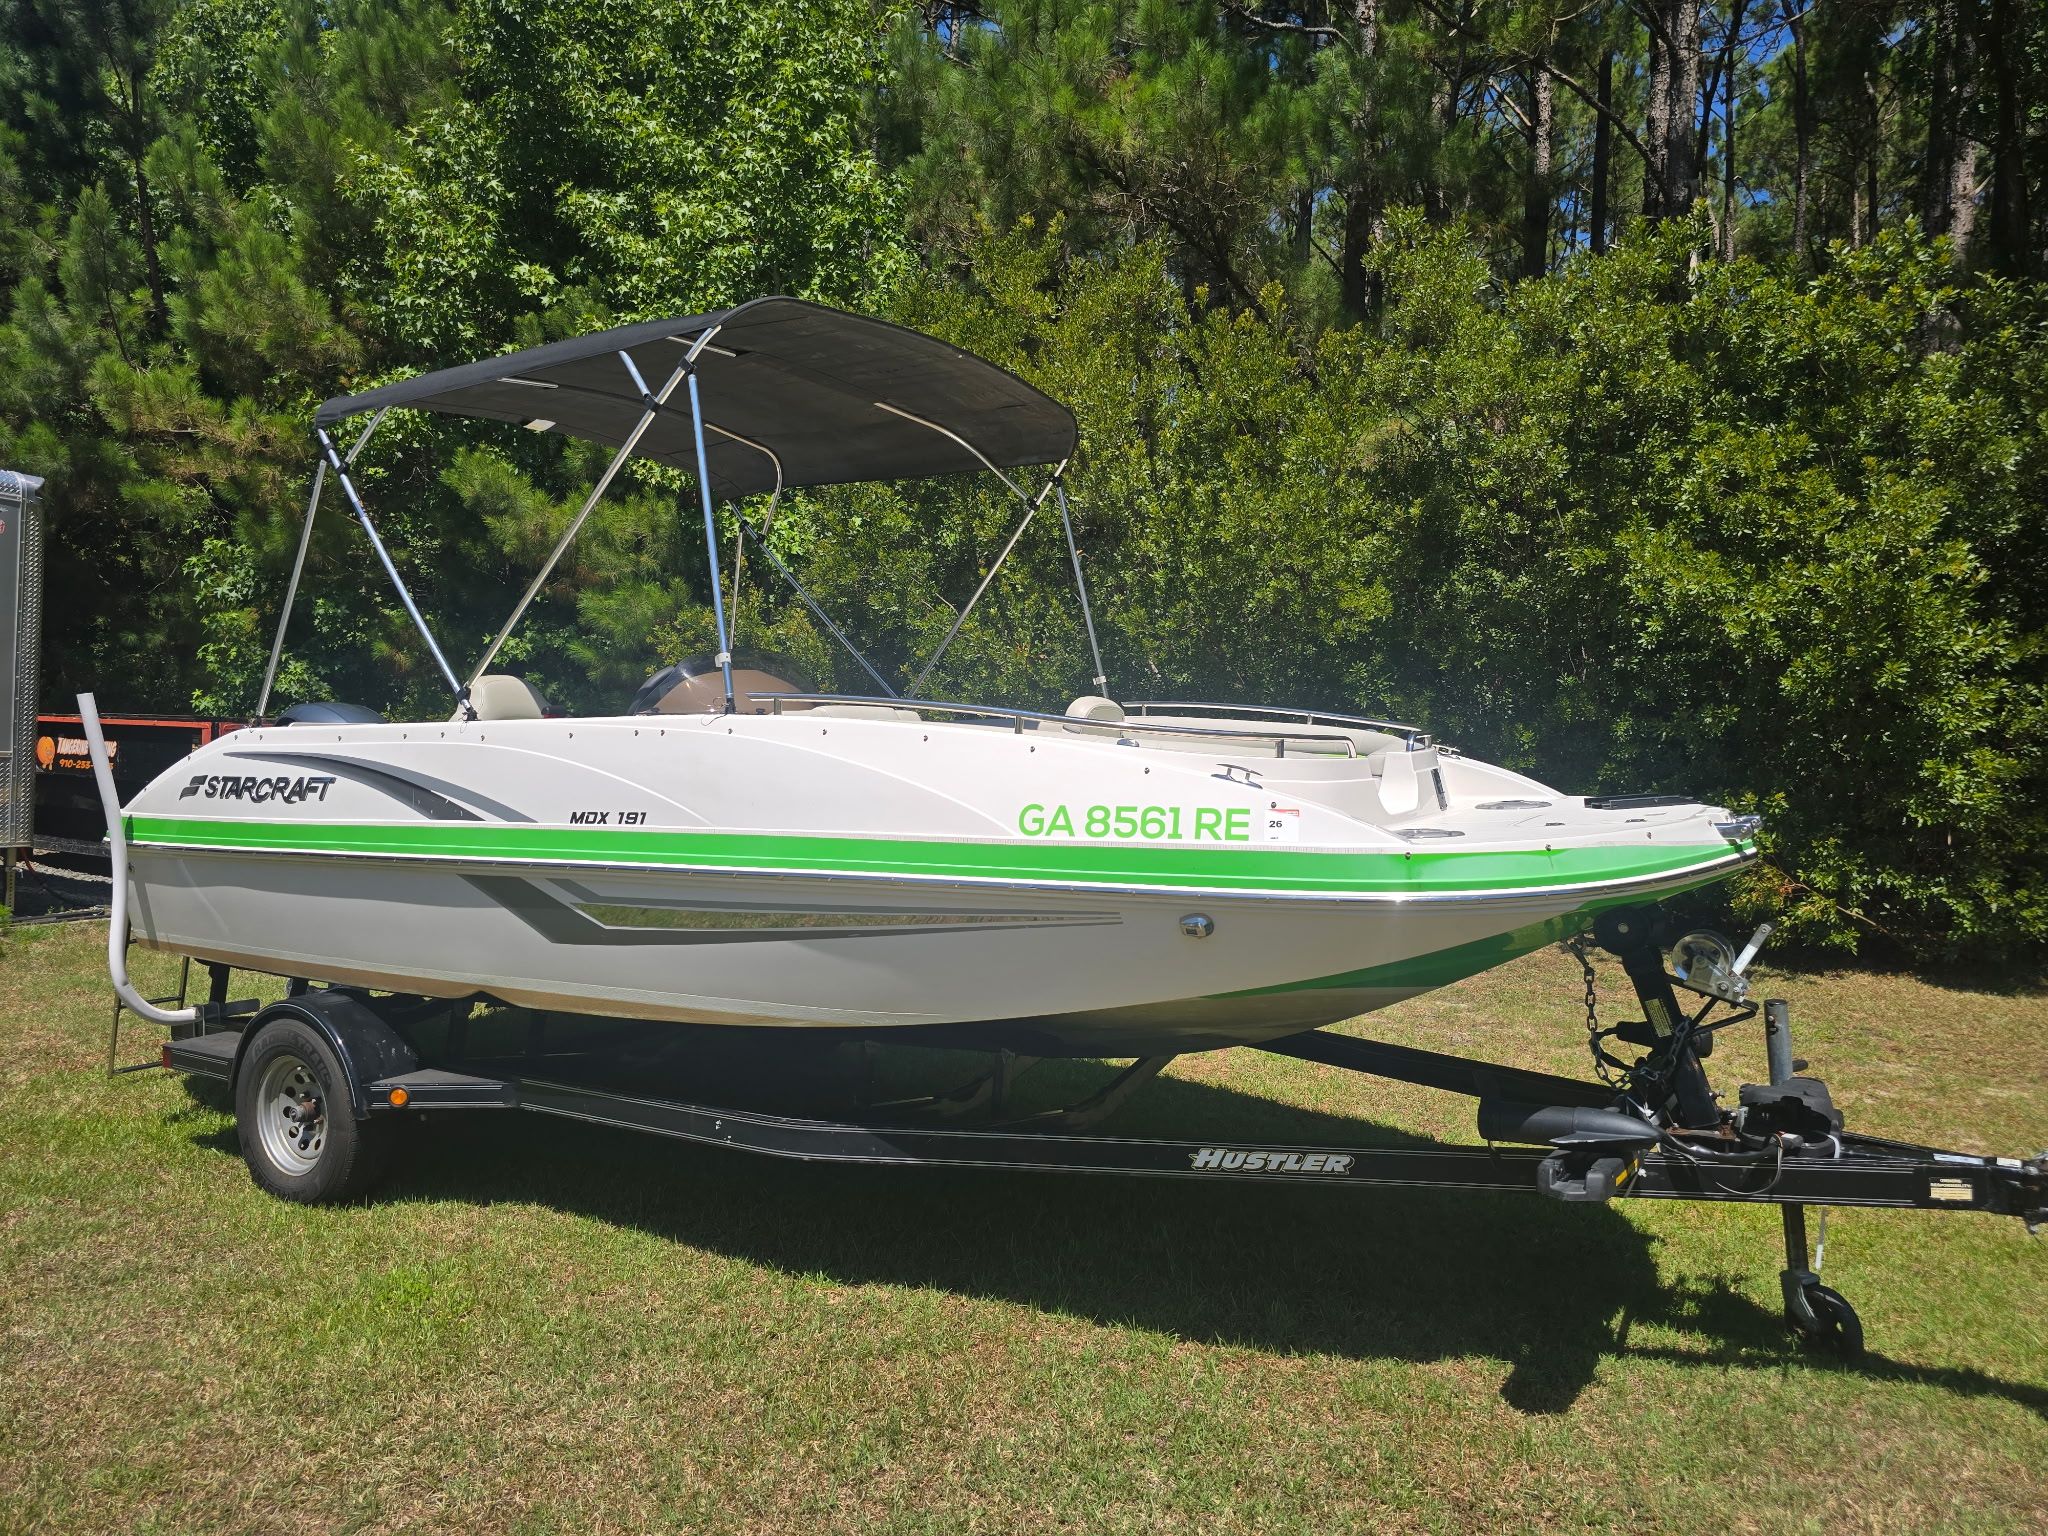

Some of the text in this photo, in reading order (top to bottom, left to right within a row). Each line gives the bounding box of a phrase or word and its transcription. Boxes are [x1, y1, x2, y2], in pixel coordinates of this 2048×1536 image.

[204, 775, 336, 804] STARCRAFT
[569, 811, 647, 825] MDX 191
[1018, 803, 1250, 841] GA 8561 RE
[1268, 820, 1283, 828] 26
[1191, 1148, 1353, 1173] HUSTLER
